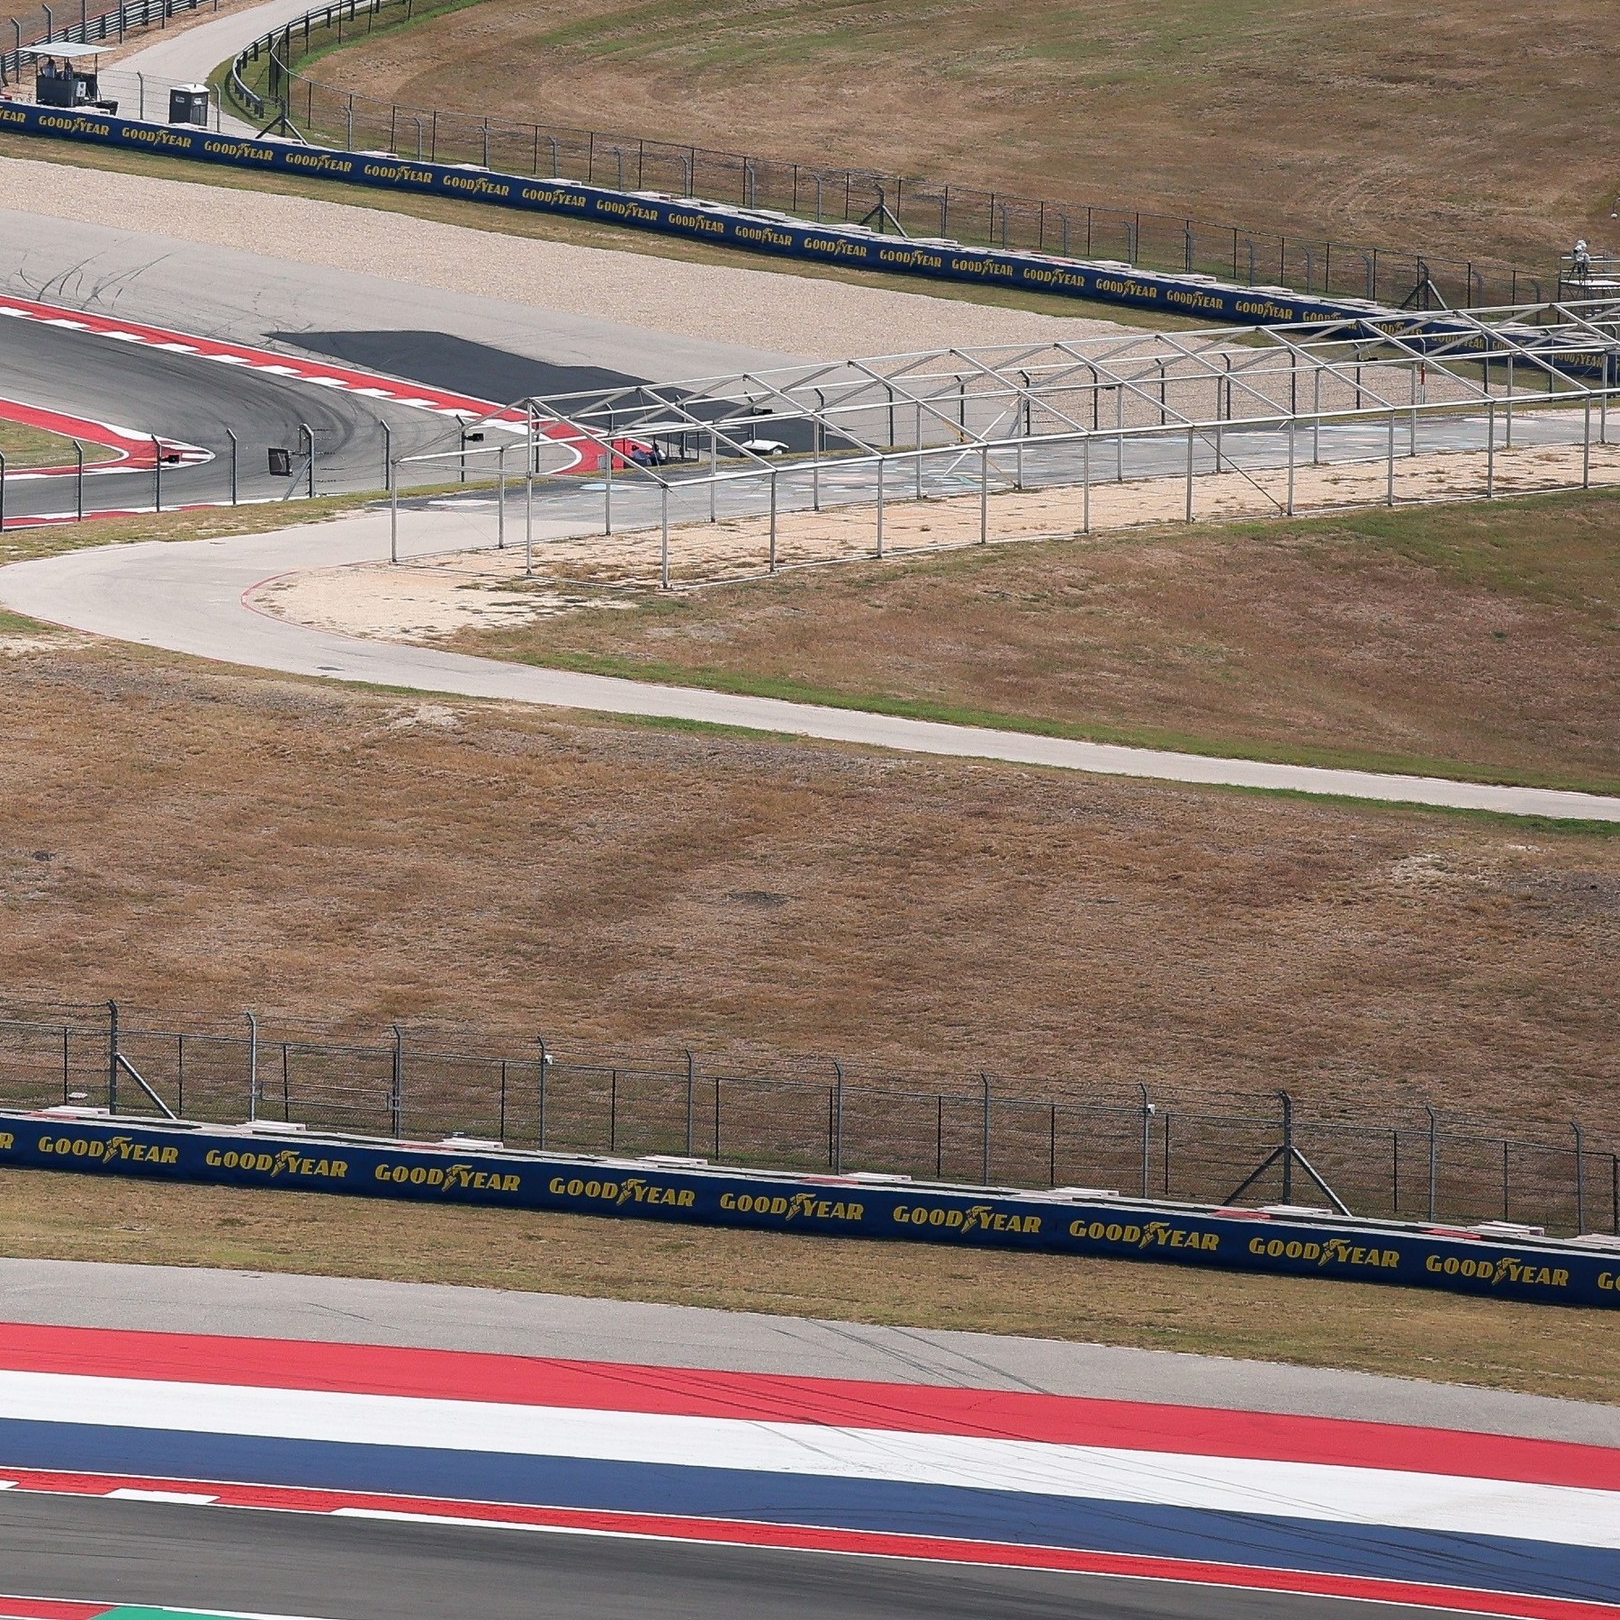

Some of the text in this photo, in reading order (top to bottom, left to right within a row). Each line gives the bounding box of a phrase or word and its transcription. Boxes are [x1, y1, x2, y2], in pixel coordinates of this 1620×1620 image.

[38, 115, 109, 135] GOODYEAR
[122, 127, 192, 148] GOODYEAR
[204, 141, 274, 160] GOODYEAR
[286, 153, 352, 171] GOODYEAR
[364, 164, 433, 183] GOODYEAR
[442, 175, 510, 195] GOODYEAR
[522, 188, 587, 206] GOODYEAR
[596, 199, 659, 220] GOODYEAR
[669, 212, 725, 232] GOODYEAR
[735, 225, 794, 246] GOODYEAR
[804, 237, 867, 256] GOODYEAR
[880, 249, 942, 268] GOODYEAR
[951, 259, 1014, 276] GOODYEAR
[1023, 268, 1086, 287] GOODYEAR
[1096, 280, 1158, 298] GOODYEAR
[1166, 289, 1224, 309] GOODYEAR
[1235, 300, 1294, 320] GOODYEAR
[38, 1135, 179, 1164] GOODYEAR
[206, 1149, 348, 1178] GOODYEAR
[375, 1163, 521, 1192] GOODYEAR
[548, 1177, 696, 1208] GOODYEAR
[720, 1192, 865, 1222] GOODYEAR
[893, 1205, 1042, 1235] GOODYEAR
[1069, 1220, 1220, 1251] GOODYEAR
[1249, 1237, 1400, 1268] GOODYEAR
[1426, 1254, 1569, 1287] GOODYEAR
